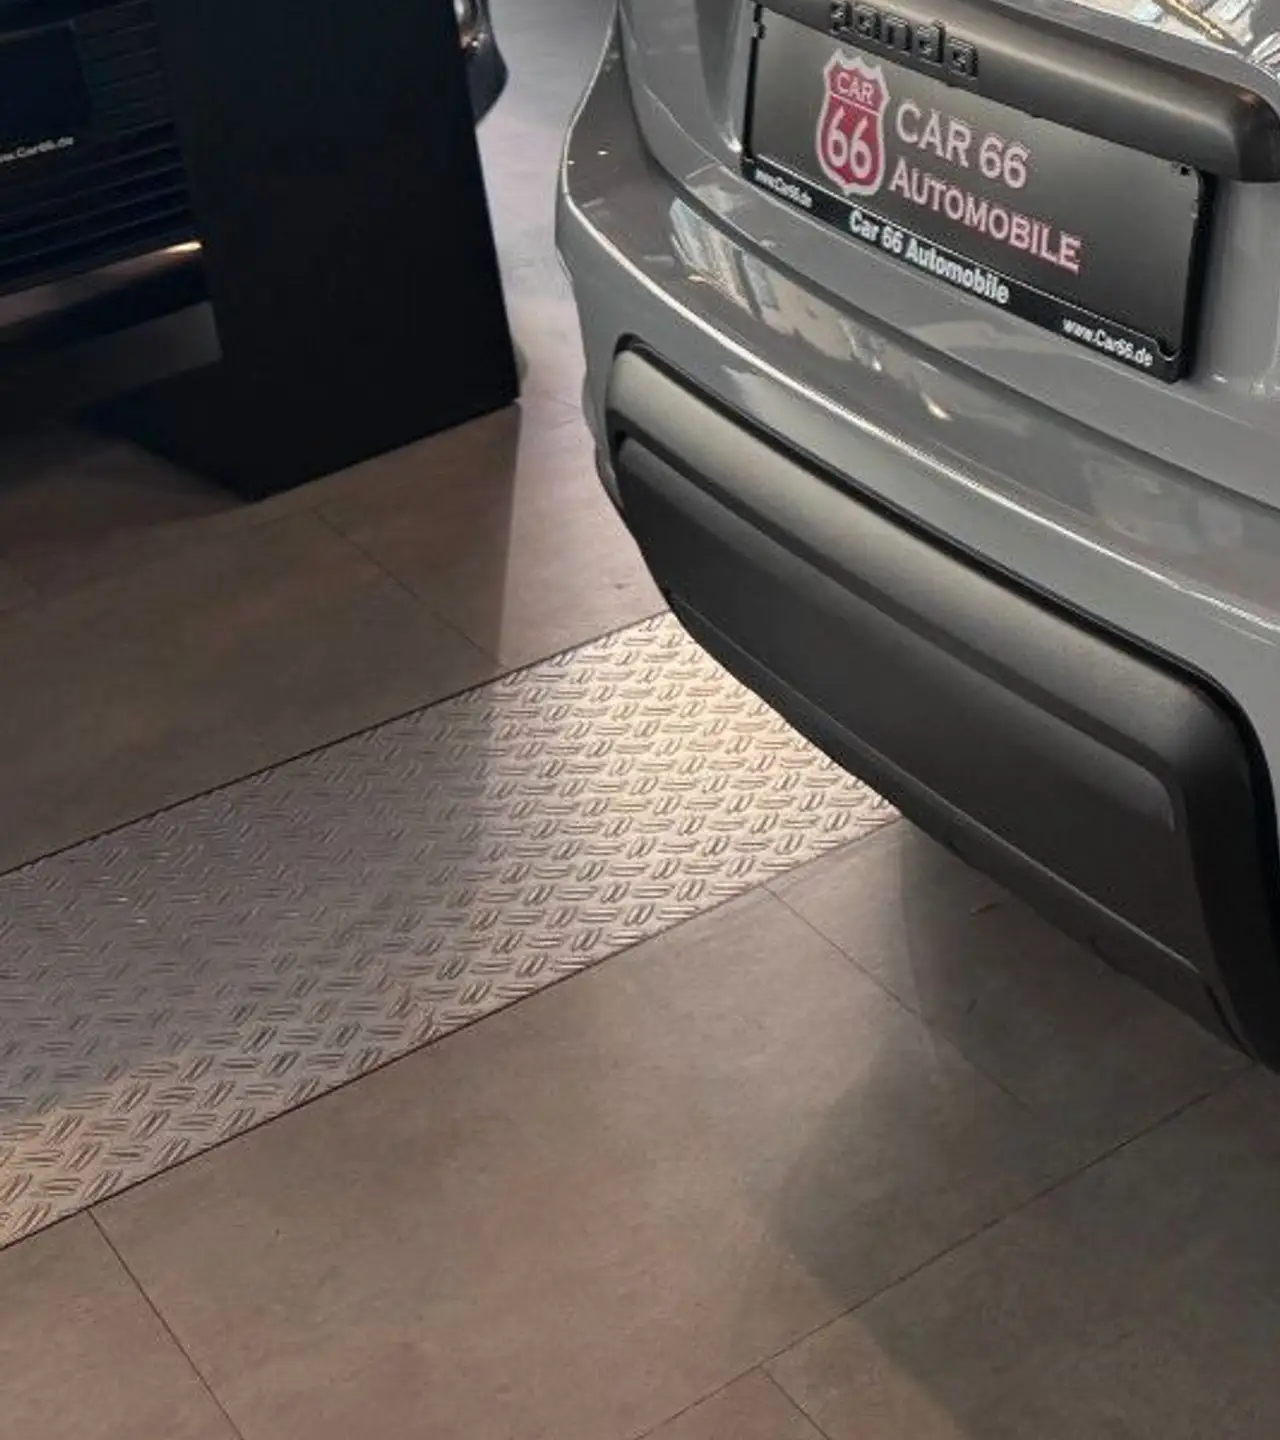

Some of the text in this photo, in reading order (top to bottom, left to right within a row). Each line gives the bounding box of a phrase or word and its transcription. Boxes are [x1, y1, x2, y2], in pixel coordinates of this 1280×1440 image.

[835, 70, 875, 107] CAR
[826, 108, 872, 179] 66
[895, 100, 1032, 191] CAR 66
[848, 208, 1011, 306] Car 66 Automobile
[889, 159, 1083, 276] AUTOMOBILE
[1061, 316, 1155, 369] www.Car66.de
